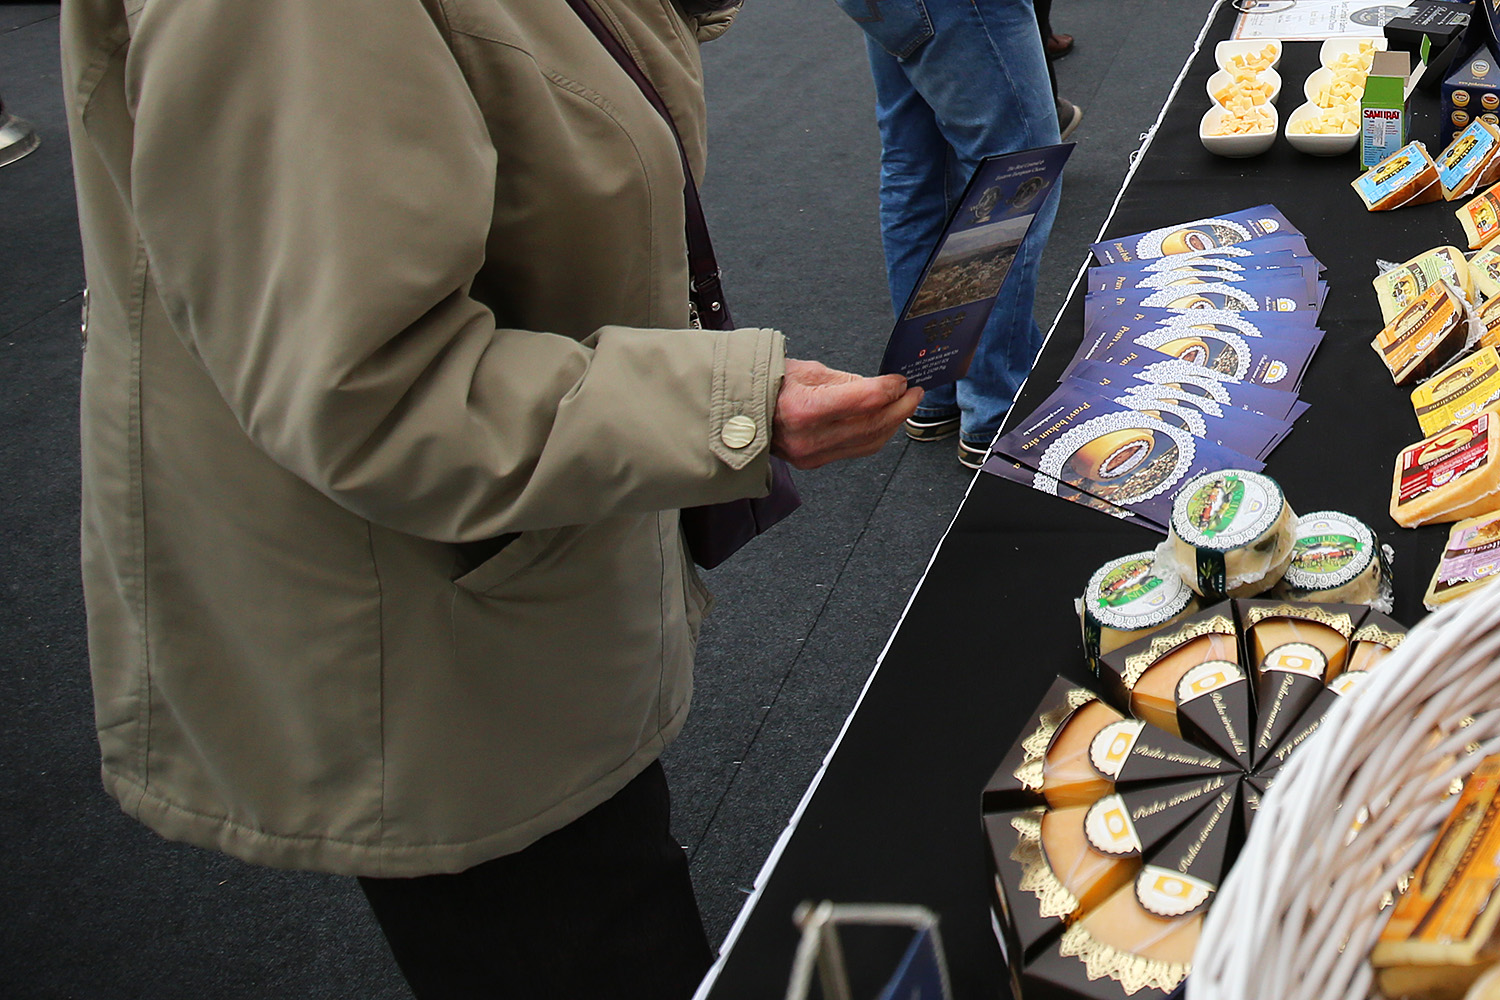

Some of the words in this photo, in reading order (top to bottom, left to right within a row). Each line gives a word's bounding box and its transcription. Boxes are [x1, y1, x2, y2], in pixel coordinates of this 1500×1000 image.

[1398, 309, 1435, 343] Primorac
[1065, 402, 1091, 421] Pravi
[1039, 419, 1069, 440] bokun
[1021, 437, 1040, 451] sira
[1279, 674, 1295, 700] Paška
[1209, 692, 1227, 716] Paška
[1220, 714, 1237, 739] sirana
[1267, 699, 1282, 729] sirana
[1132, 744, 1166, 760] Paška
[1166, 752, 1199, 766] sirana
[1132, 800, 1167, 822] Paška
[1167, 787, 1202, 808] sirana
[1178, 840, 1202, 875] Paška
[1199, 811, 1220, 844] sirana
